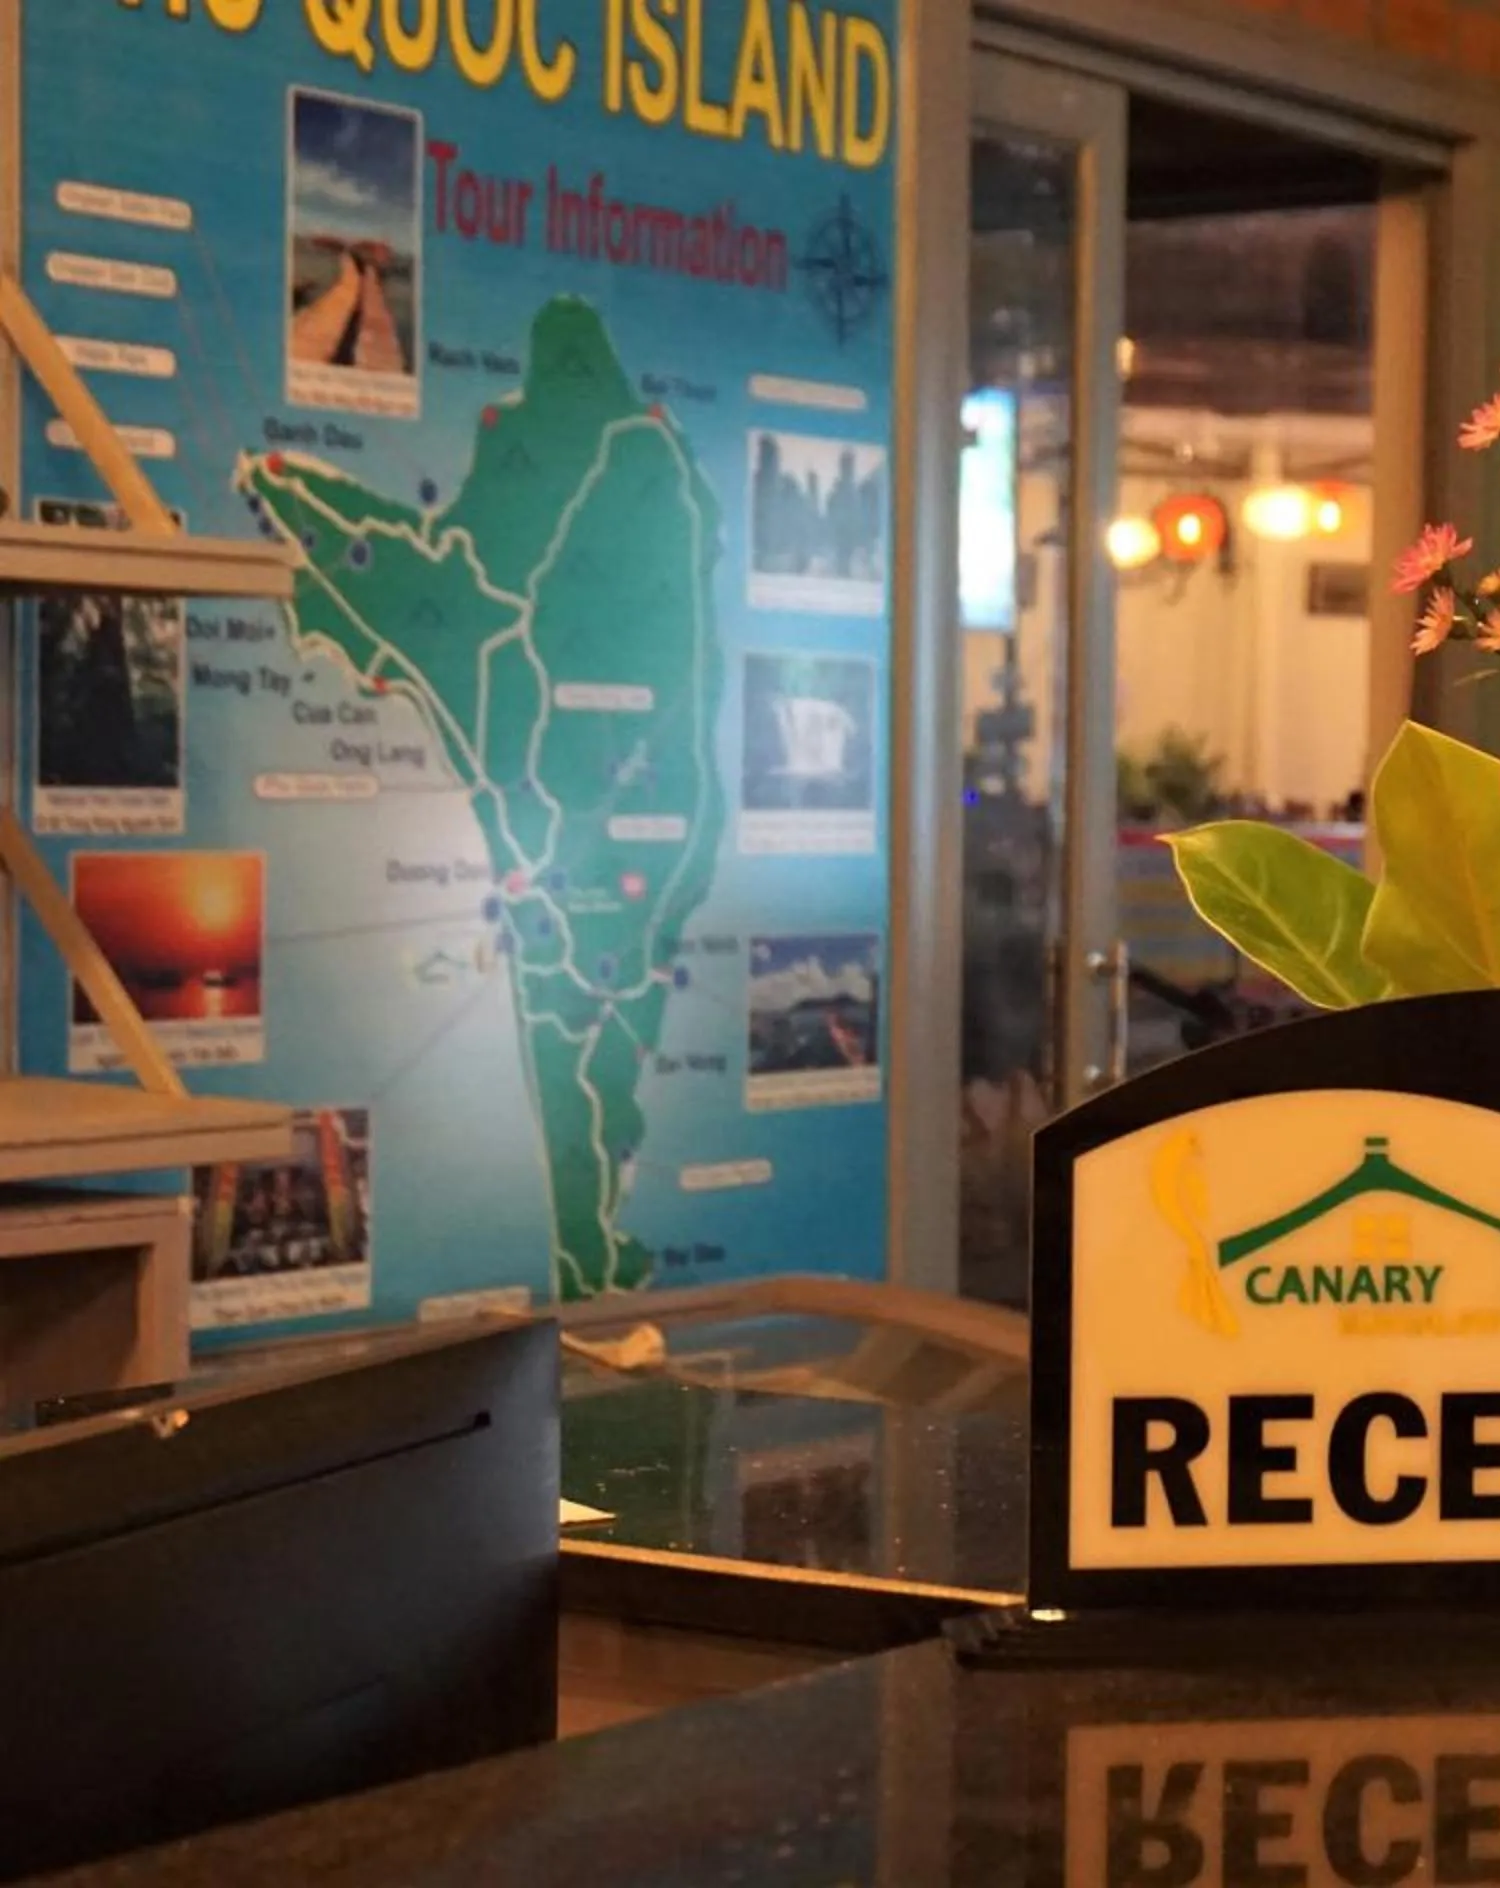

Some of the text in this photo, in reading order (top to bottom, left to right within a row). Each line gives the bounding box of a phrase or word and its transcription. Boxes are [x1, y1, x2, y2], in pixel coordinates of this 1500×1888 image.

[604, 0, 891, 169] ISLAND
[425, 139, 788, 292] Tour Information
[1245, 1265, 1444, 1305] CANARY
